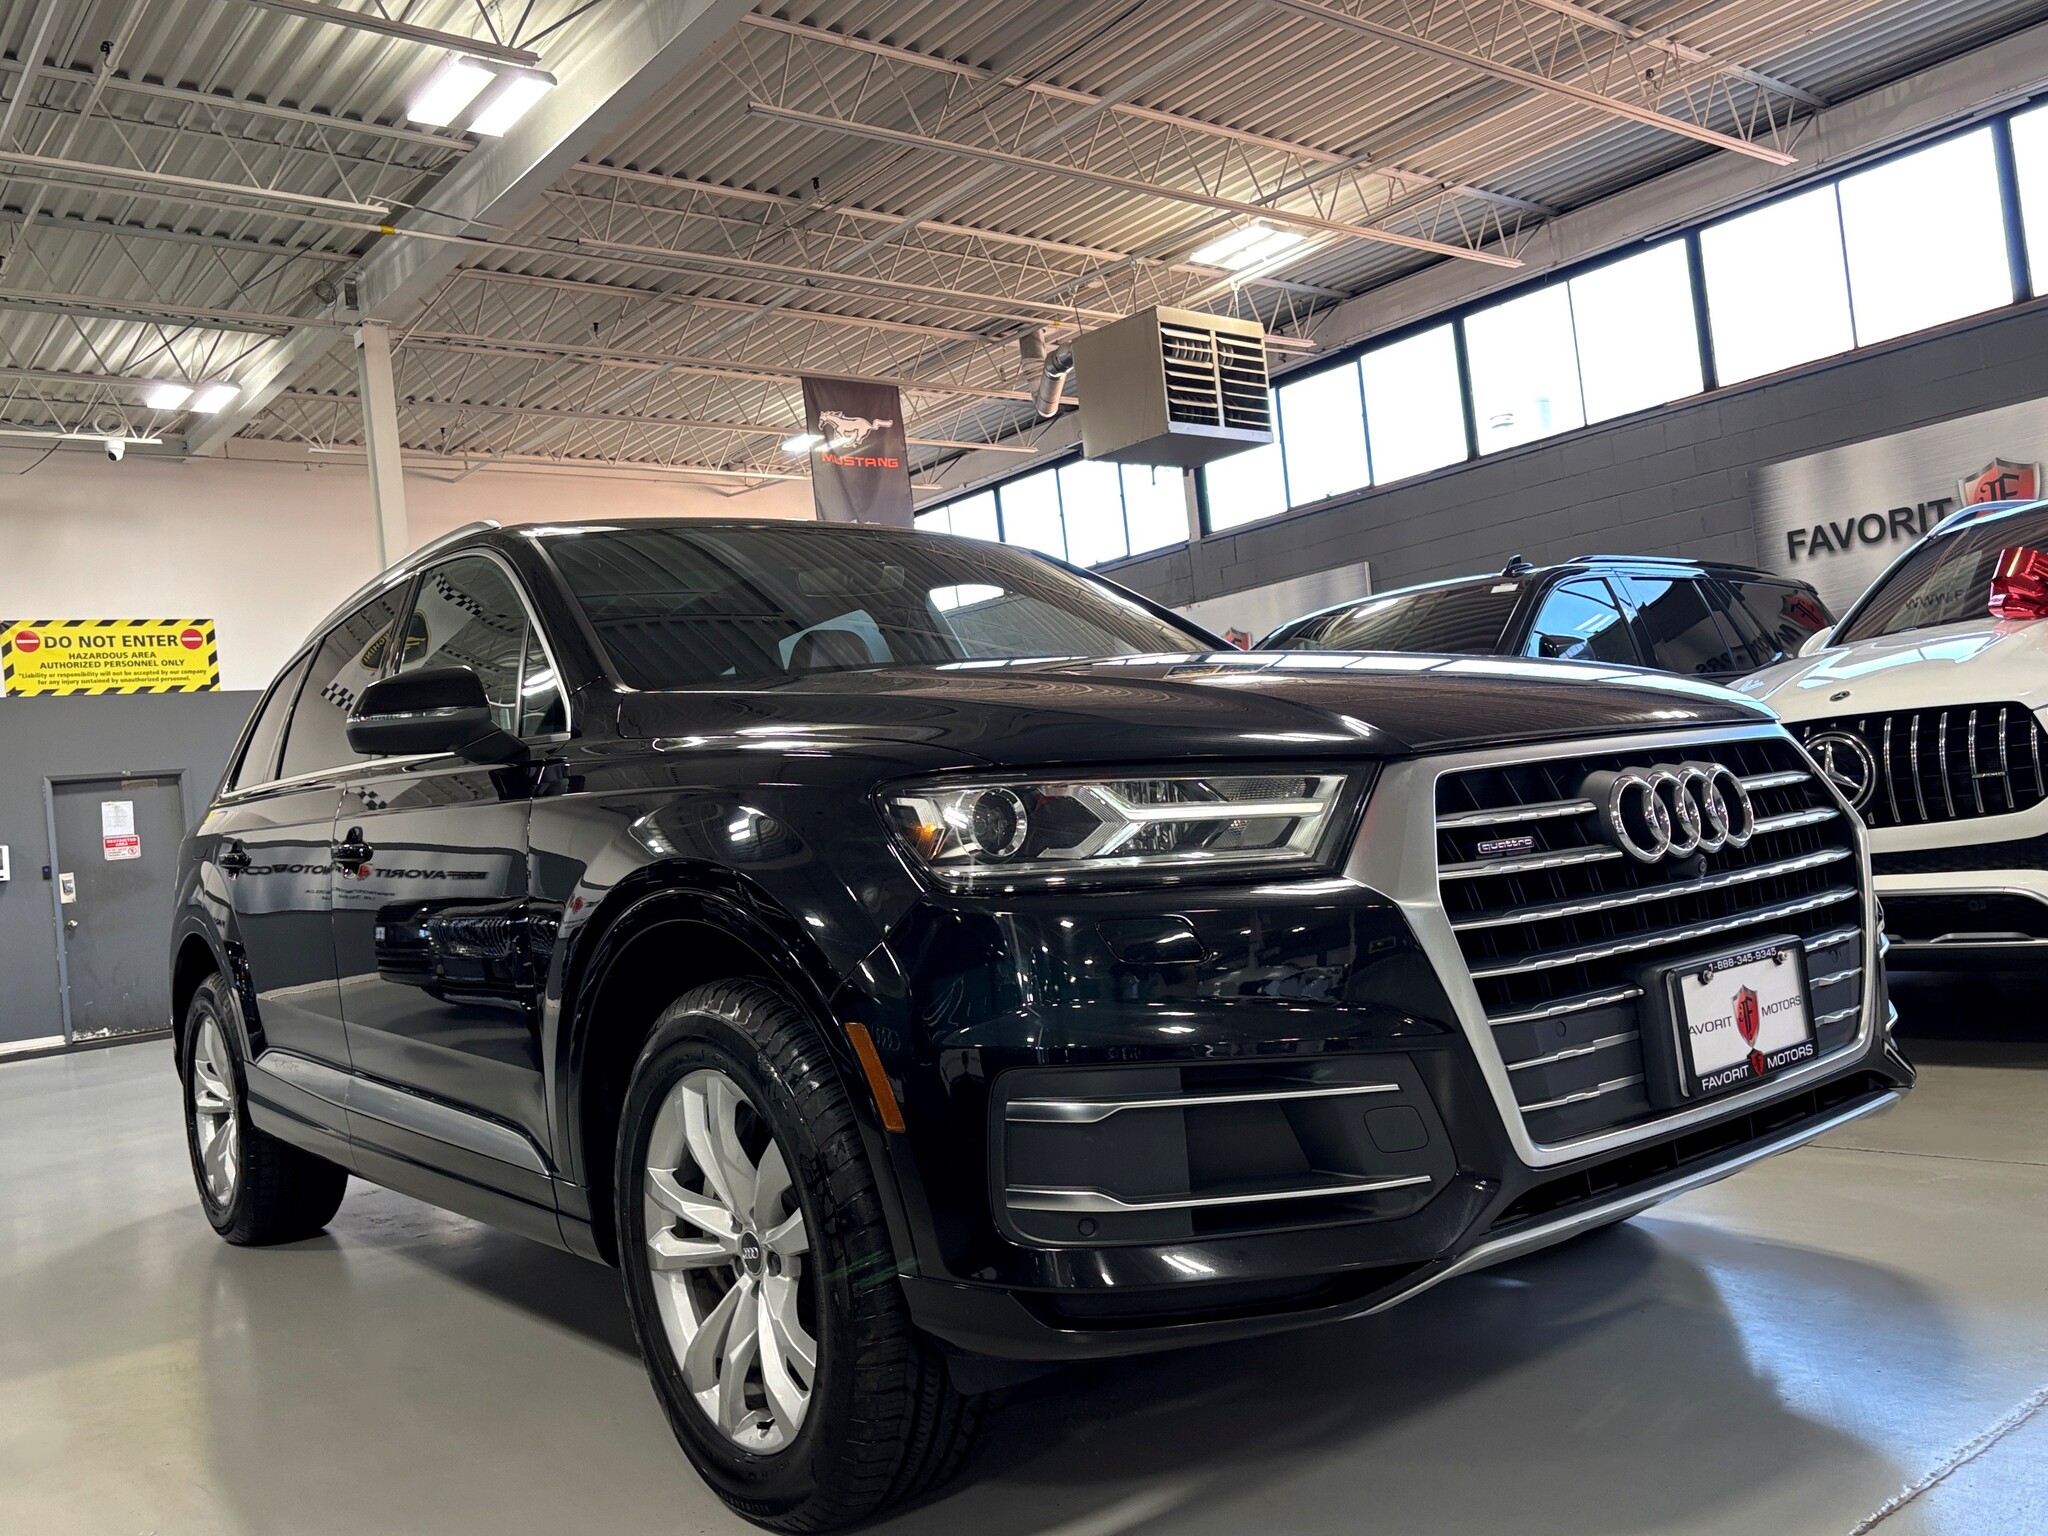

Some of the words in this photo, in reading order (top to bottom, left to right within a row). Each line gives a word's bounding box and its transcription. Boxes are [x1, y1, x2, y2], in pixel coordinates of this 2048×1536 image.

[821, 452, 899, 468] MUSTANG
[1786, 496, 1953, 560] FAVORIT
[44, 636, 72, 649] DO
[79, 635, 116, 648] NOT
[122, 634, 179, 647] ENTER
[68, 652, 129, 660] HAZARDOUS
[131, 651, 157, 659] AREA
[40, 661, 101, 669] AUTHORIZED
[104, 660, 159, 668] PERSONNEL
[161, 659, 185, 667] ONLY
[1481, 838, 1532, 851] quattro
[1708, 948, 1777, 972] 1-888-345-9345
[1688, 1015, 1733, 1036] AVORIT
[1761, 995, 1802, 1017] MOTORS
[1701, 1064, 1750, 1091] FAVORIT
[1766, 1043, 1814, 1069] MOTORS
